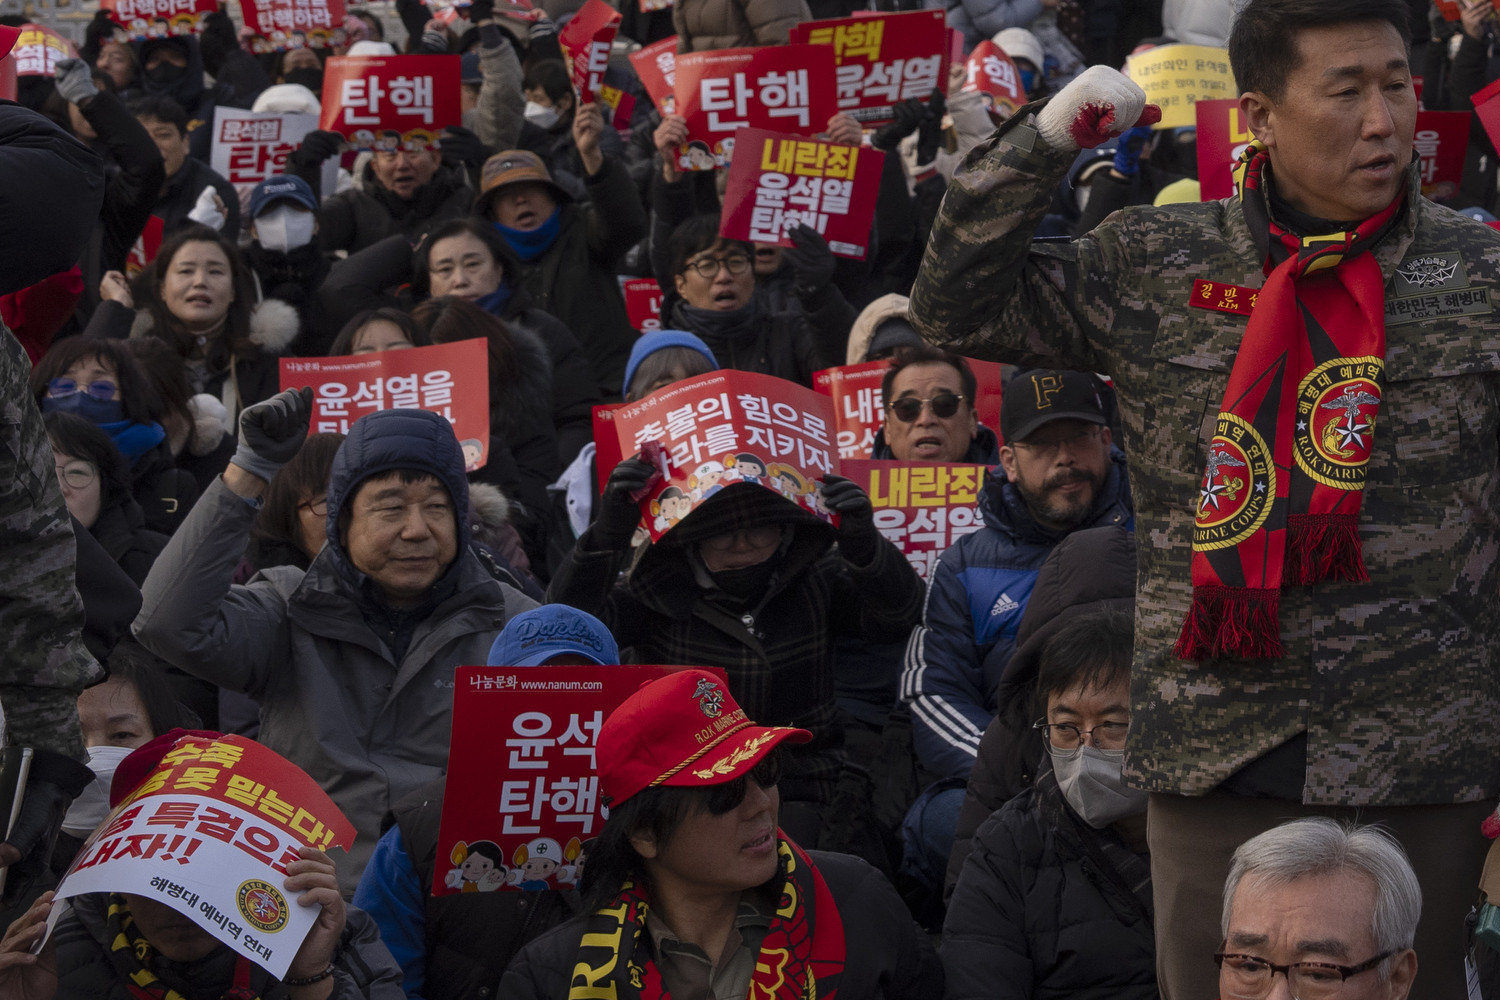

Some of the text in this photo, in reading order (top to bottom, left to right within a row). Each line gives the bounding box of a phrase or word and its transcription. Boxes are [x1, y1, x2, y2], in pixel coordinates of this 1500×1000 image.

[256, 5, 333, 34] 탄핵하라
[14, 30, 69, 57] 란죄
[837, 55, 942, 102] 윤석열
[342, 75, 435, 126] 탄핵
[701, 69, 810, 132] 탄핵
[223, 120, 280, 141] 윤석열
[760, 137, 860, 181] 내란죄
[755, 172, 854, 215] 윤석열
[1385, 289, 1488, 318] 대한민국 해병대
[1410, 310, 1434, 320] R.O.K.
[322, 359, 383, 372] www.nanum.com
[316, 369, 456, 418] 윤석열을
[659, 375, 727, 401] www.nanum.com
[1031, 371, 1064, 411] P
[1298, 364, 1381, 415] 해병대 예비역
[739, 393, 831, 448] 힘으로
[745, 427, 835, 476] 지키자
[1213, 421, 1268, 476] 비역 연대
[1298, 435, 1322, 469] R.O.K
[871, 466, 985, 508] 내란죄
[1230, 494, 1264, 532] CORPS
[990, 600, 1020, 617] adidas
[470, 674, 604, 692] 나눔문화 www.nanum.com
[163, 741, 245, 770] 수족
[694, 724, 717, 745] R.O.K
[173, 767, 219, 793] 못
[223, 774, 337, 853] 믿는다!
[499, 775, 600, 835] 탄핵
[71, 833, 204, 876] 내자!!
[150, 875, 275, 963] 해병대 예비역 연대
